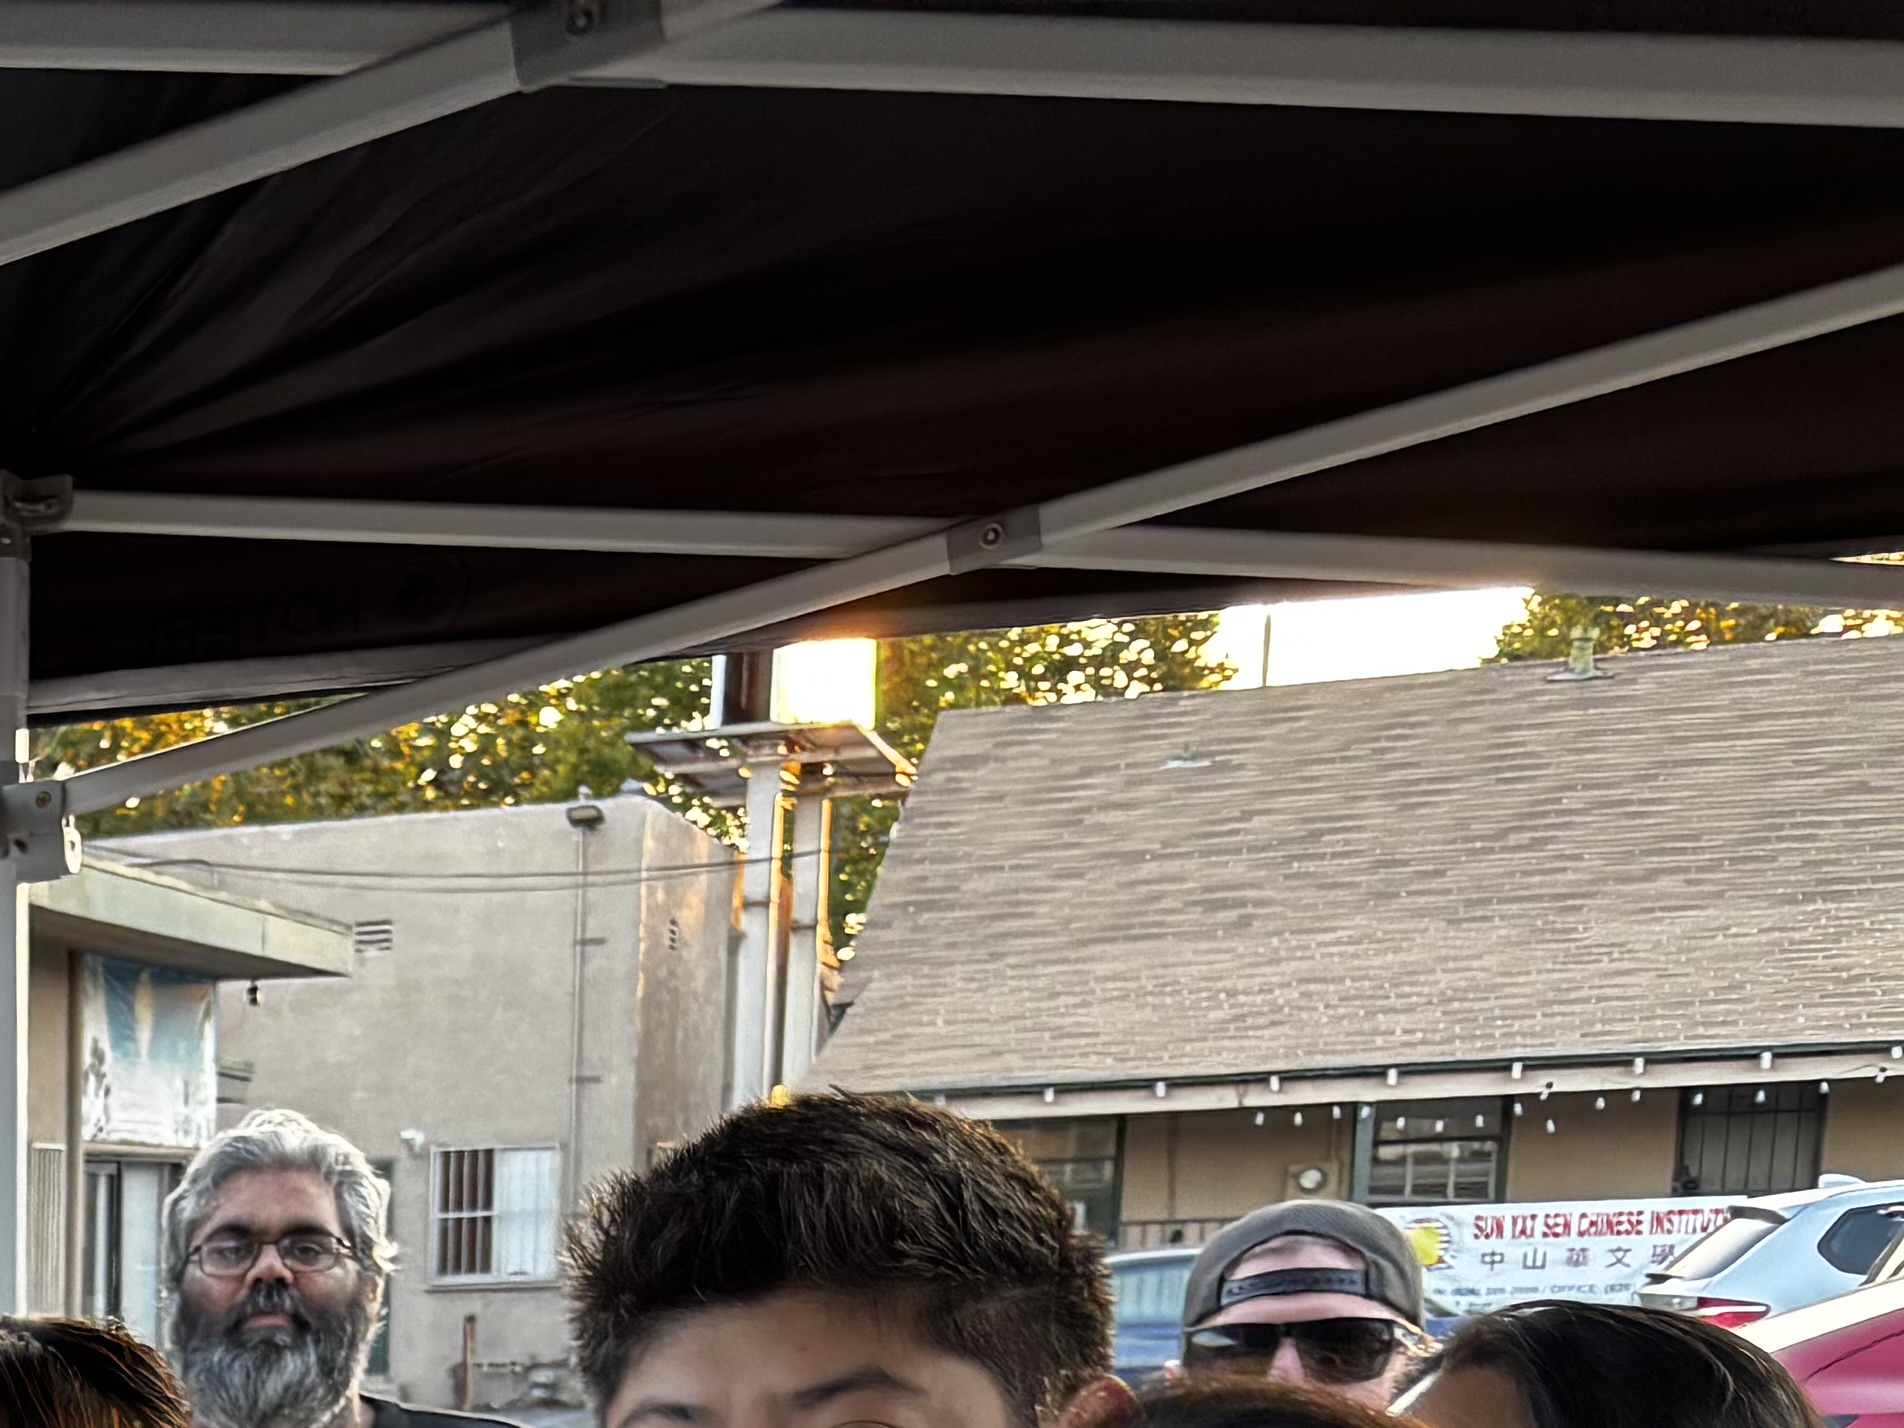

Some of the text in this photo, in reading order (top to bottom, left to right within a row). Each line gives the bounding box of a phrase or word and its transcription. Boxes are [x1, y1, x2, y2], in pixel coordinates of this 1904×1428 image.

[1474, 1214, 1505, 1240] SUN
[1511, 1213, 1538, 1239] YAT
[1542, 1212, 1571, 1238] SEN
[1577, 1210, 1644, 1237] CHINESE
